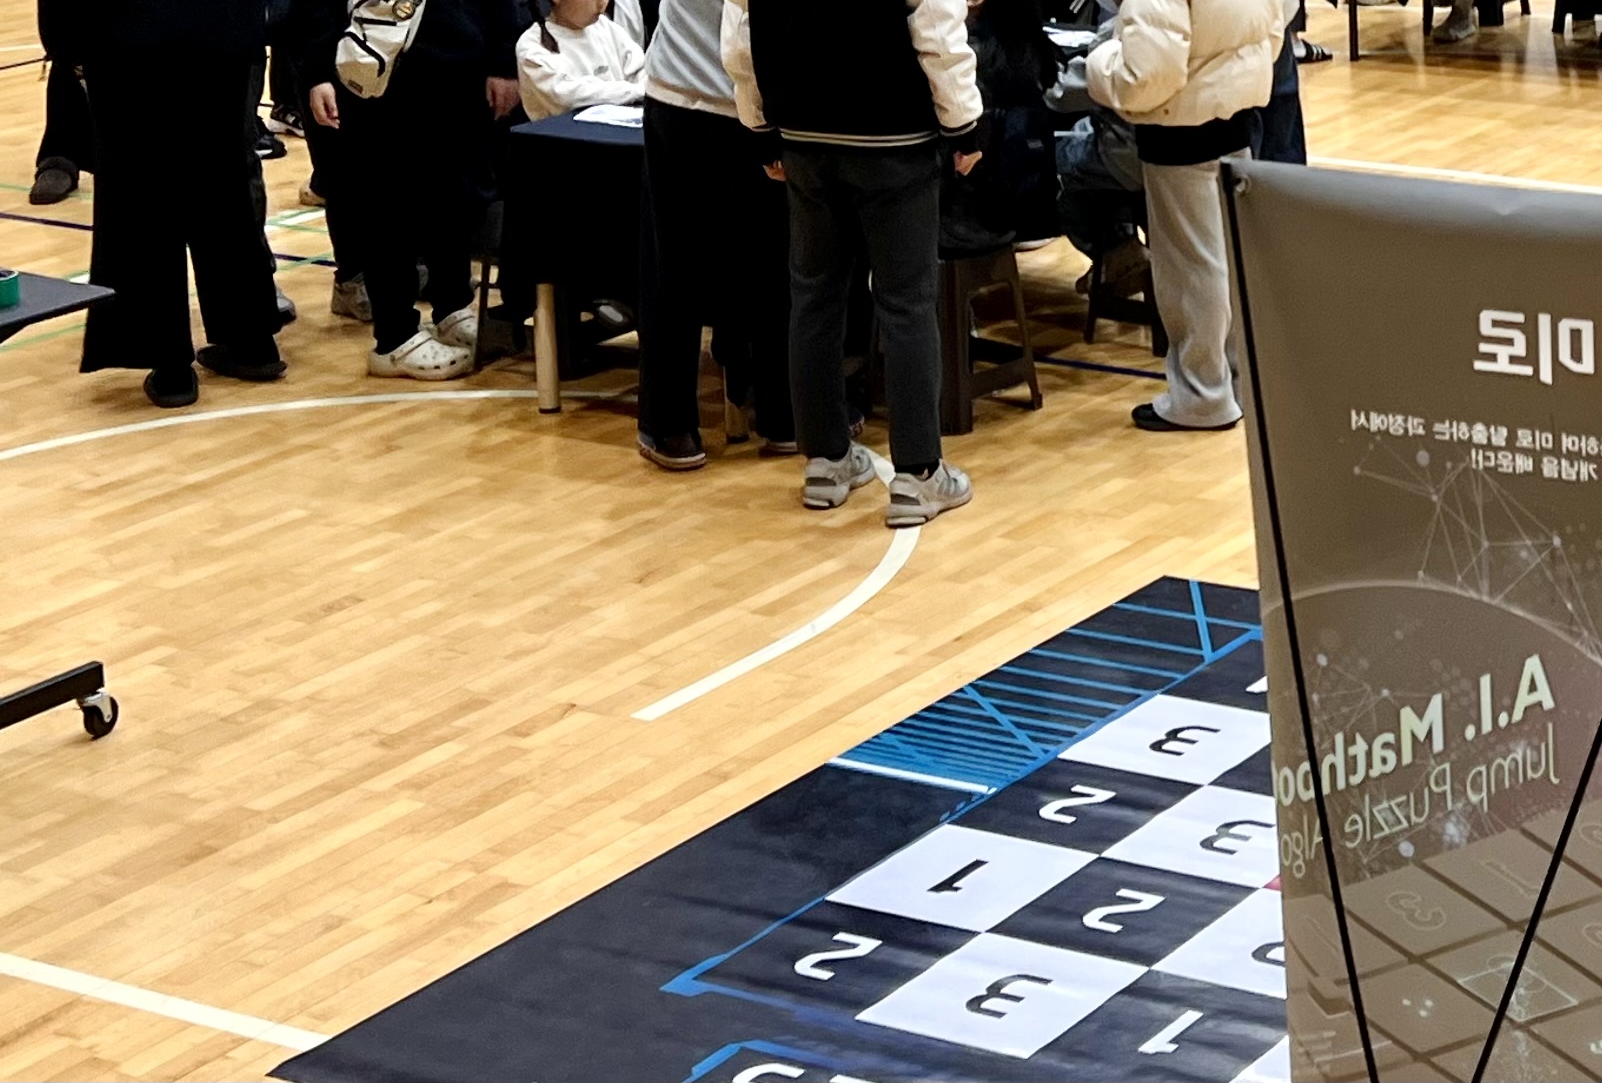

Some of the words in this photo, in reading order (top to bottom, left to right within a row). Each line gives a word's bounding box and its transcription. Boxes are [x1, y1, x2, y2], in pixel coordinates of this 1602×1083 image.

[1149, 725, 1221, 756] 3
[1038, 784, 1117, 824] 2
[1199, 820, 1277, 855] 3
[928, 858, 989, 893] 1
[1082, 888, 1166, 933] 2
[794, 932, 883, 981] 2
[965, 973, 1054, 1018] 3
[1137, 1009, 1205, 1055] 1
